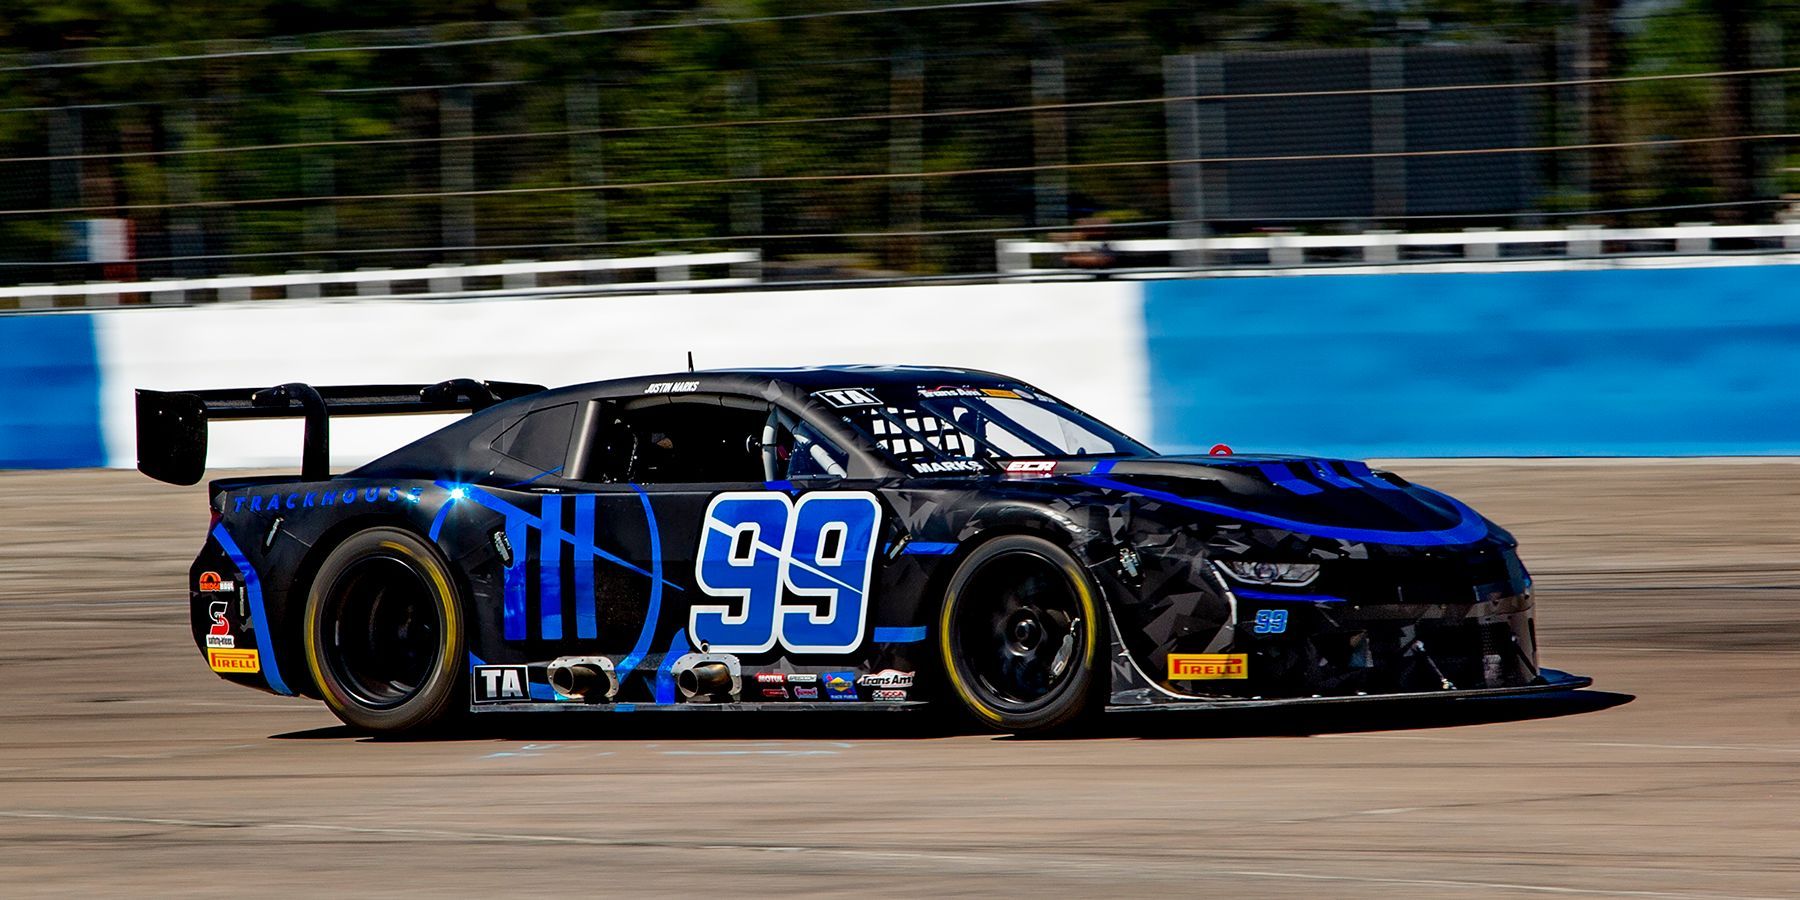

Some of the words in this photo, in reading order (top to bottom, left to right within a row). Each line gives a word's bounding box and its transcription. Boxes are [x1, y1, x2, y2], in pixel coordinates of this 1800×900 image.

[644, 382, 674, 393] JUSTIN
[671, 381, 700, 392] MARKS
[825, 389, 875, 405] TA
[912, 460, 984, 473] MARKS
[1006, 461, 1057, 471] ECR
[234, 486, 423, 513] TRACKHOUSE
[688, 491, 882, 654] 99
[1254, 609, 1288, 633] 99
[210, 652, 256, 669] PIRELLI
[1173, 658, 1242, 675] PIRELLI
[481, 669, 523, 698] TA
[758, 674, 784, 682] MOTUL
[862, 675, 891, 685] Trans
[891, 675, 911, 684] Am
